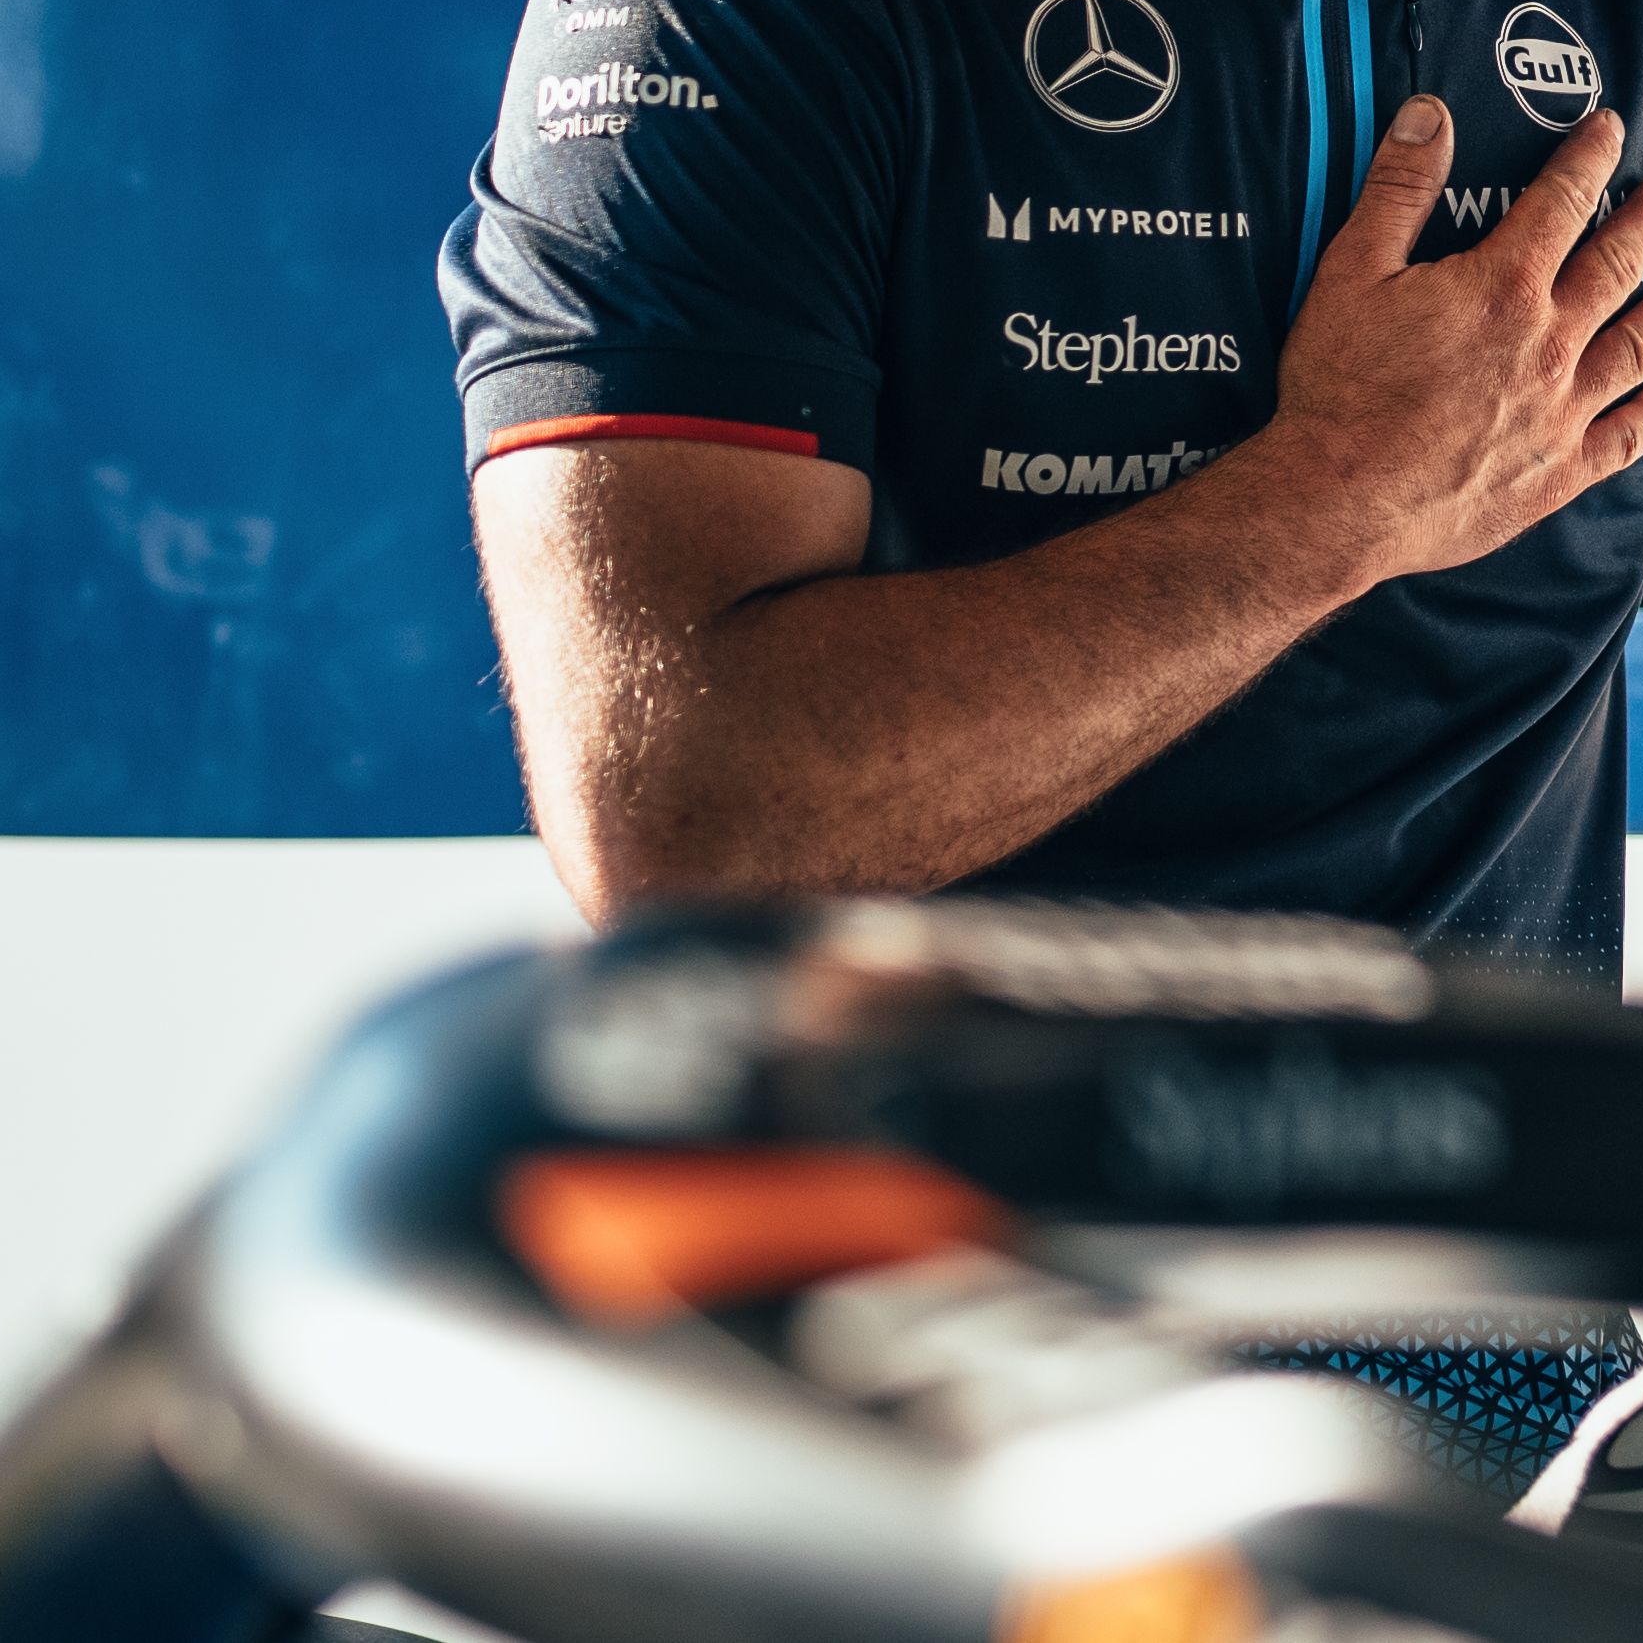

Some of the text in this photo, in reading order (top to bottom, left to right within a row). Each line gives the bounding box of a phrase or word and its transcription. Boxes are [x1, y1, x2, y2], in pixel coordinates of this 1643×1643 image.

[537, 61, 719, 117] Dorilton.
[1504, 44, 1594, 87] Gulf
[1049, 207, 1250, 238] MYPROTEIN
[1002, 312, 1241, 385] Stephens
[981, 440, 1228, 496] KOMATS
